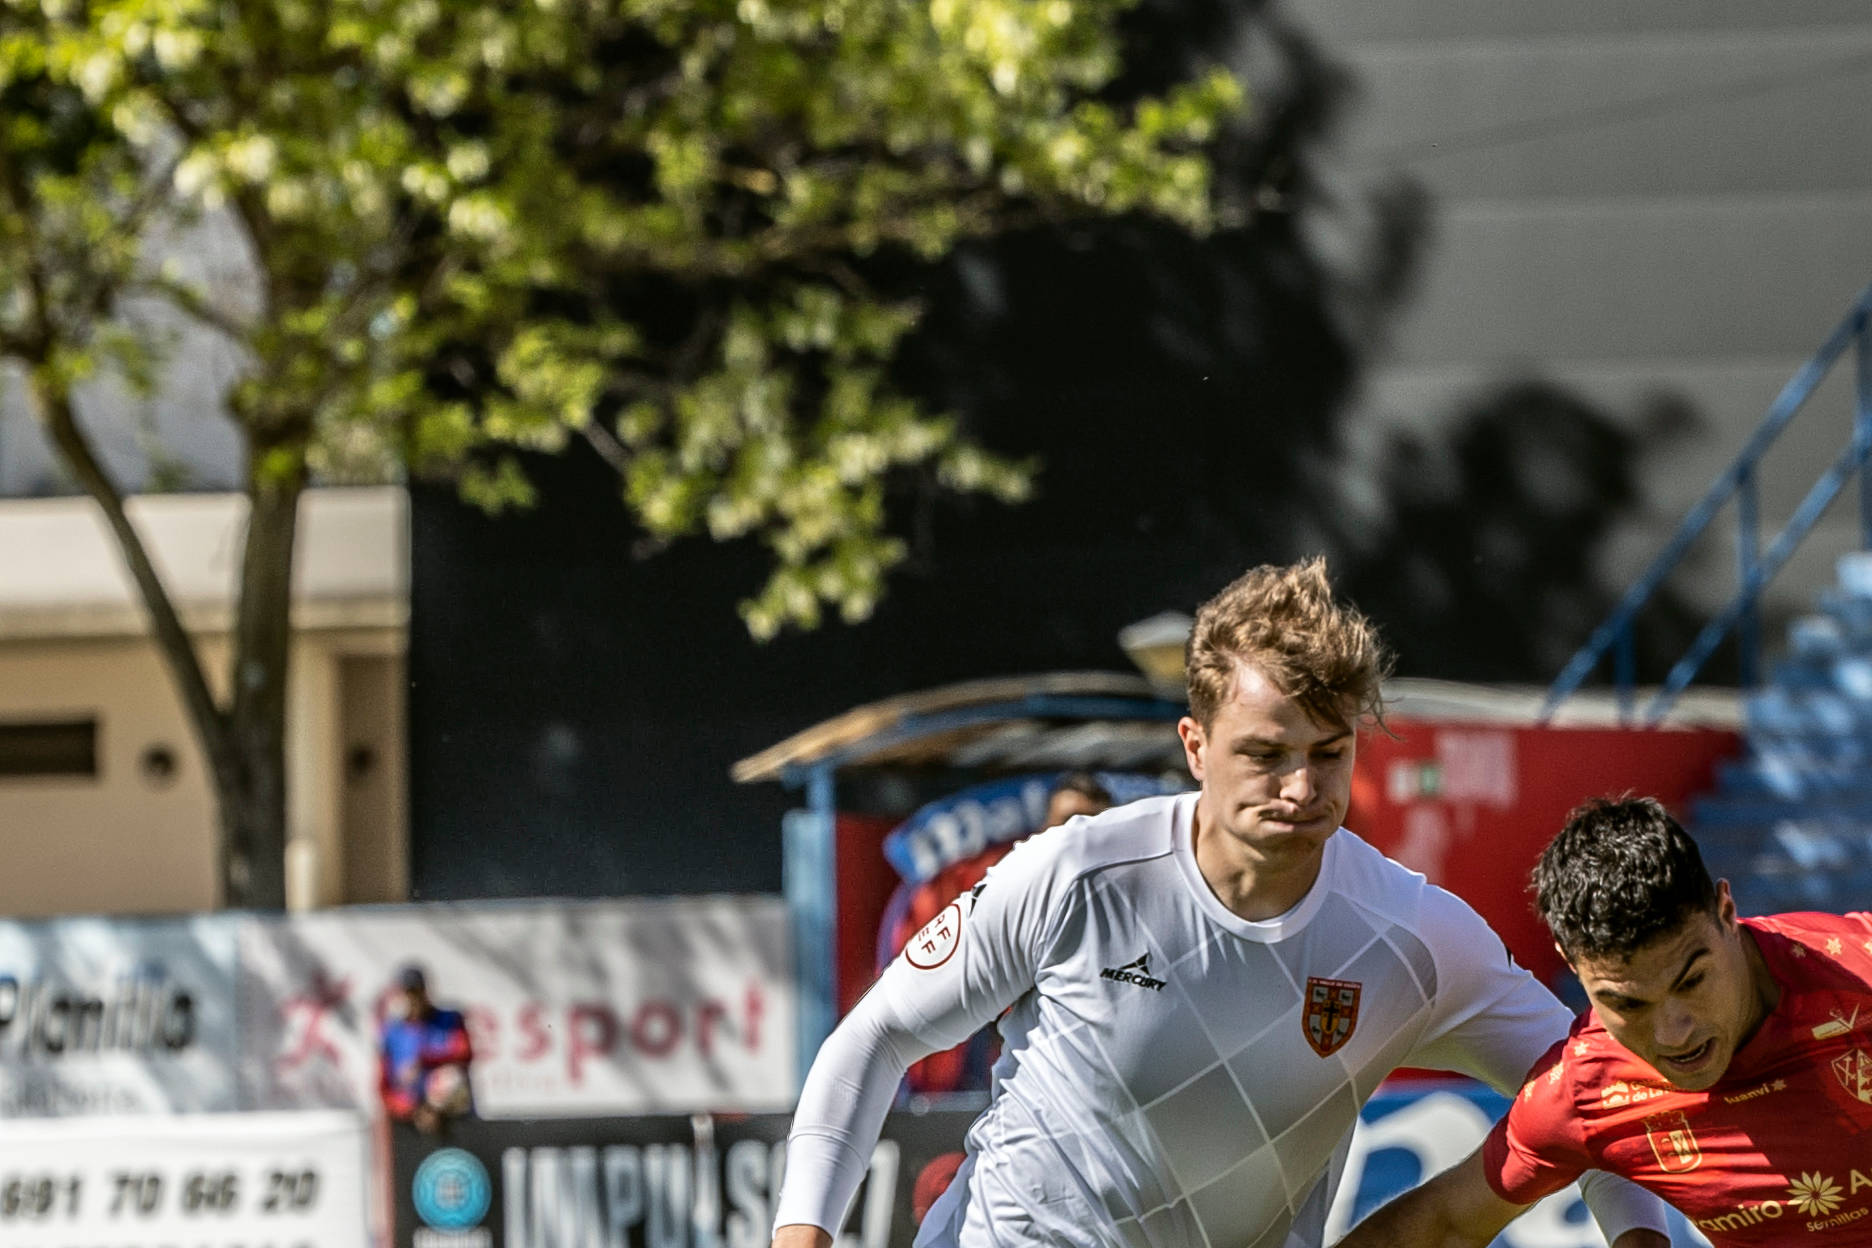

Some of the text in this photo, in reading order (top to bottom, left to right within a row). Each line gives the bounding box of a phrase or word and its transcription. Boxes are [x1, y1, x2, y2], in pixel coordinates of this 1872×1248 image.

[1099, 967, 1168, 992] MERCURY
[376, 980, 766, 1084] esport
[108, 1171, 163, 1217] 70
[262, 1168, 320, 1212] 20
[1690, 1199, 1784, 1232] amiro
[1805, 1206, 1870, 1233] semillas
